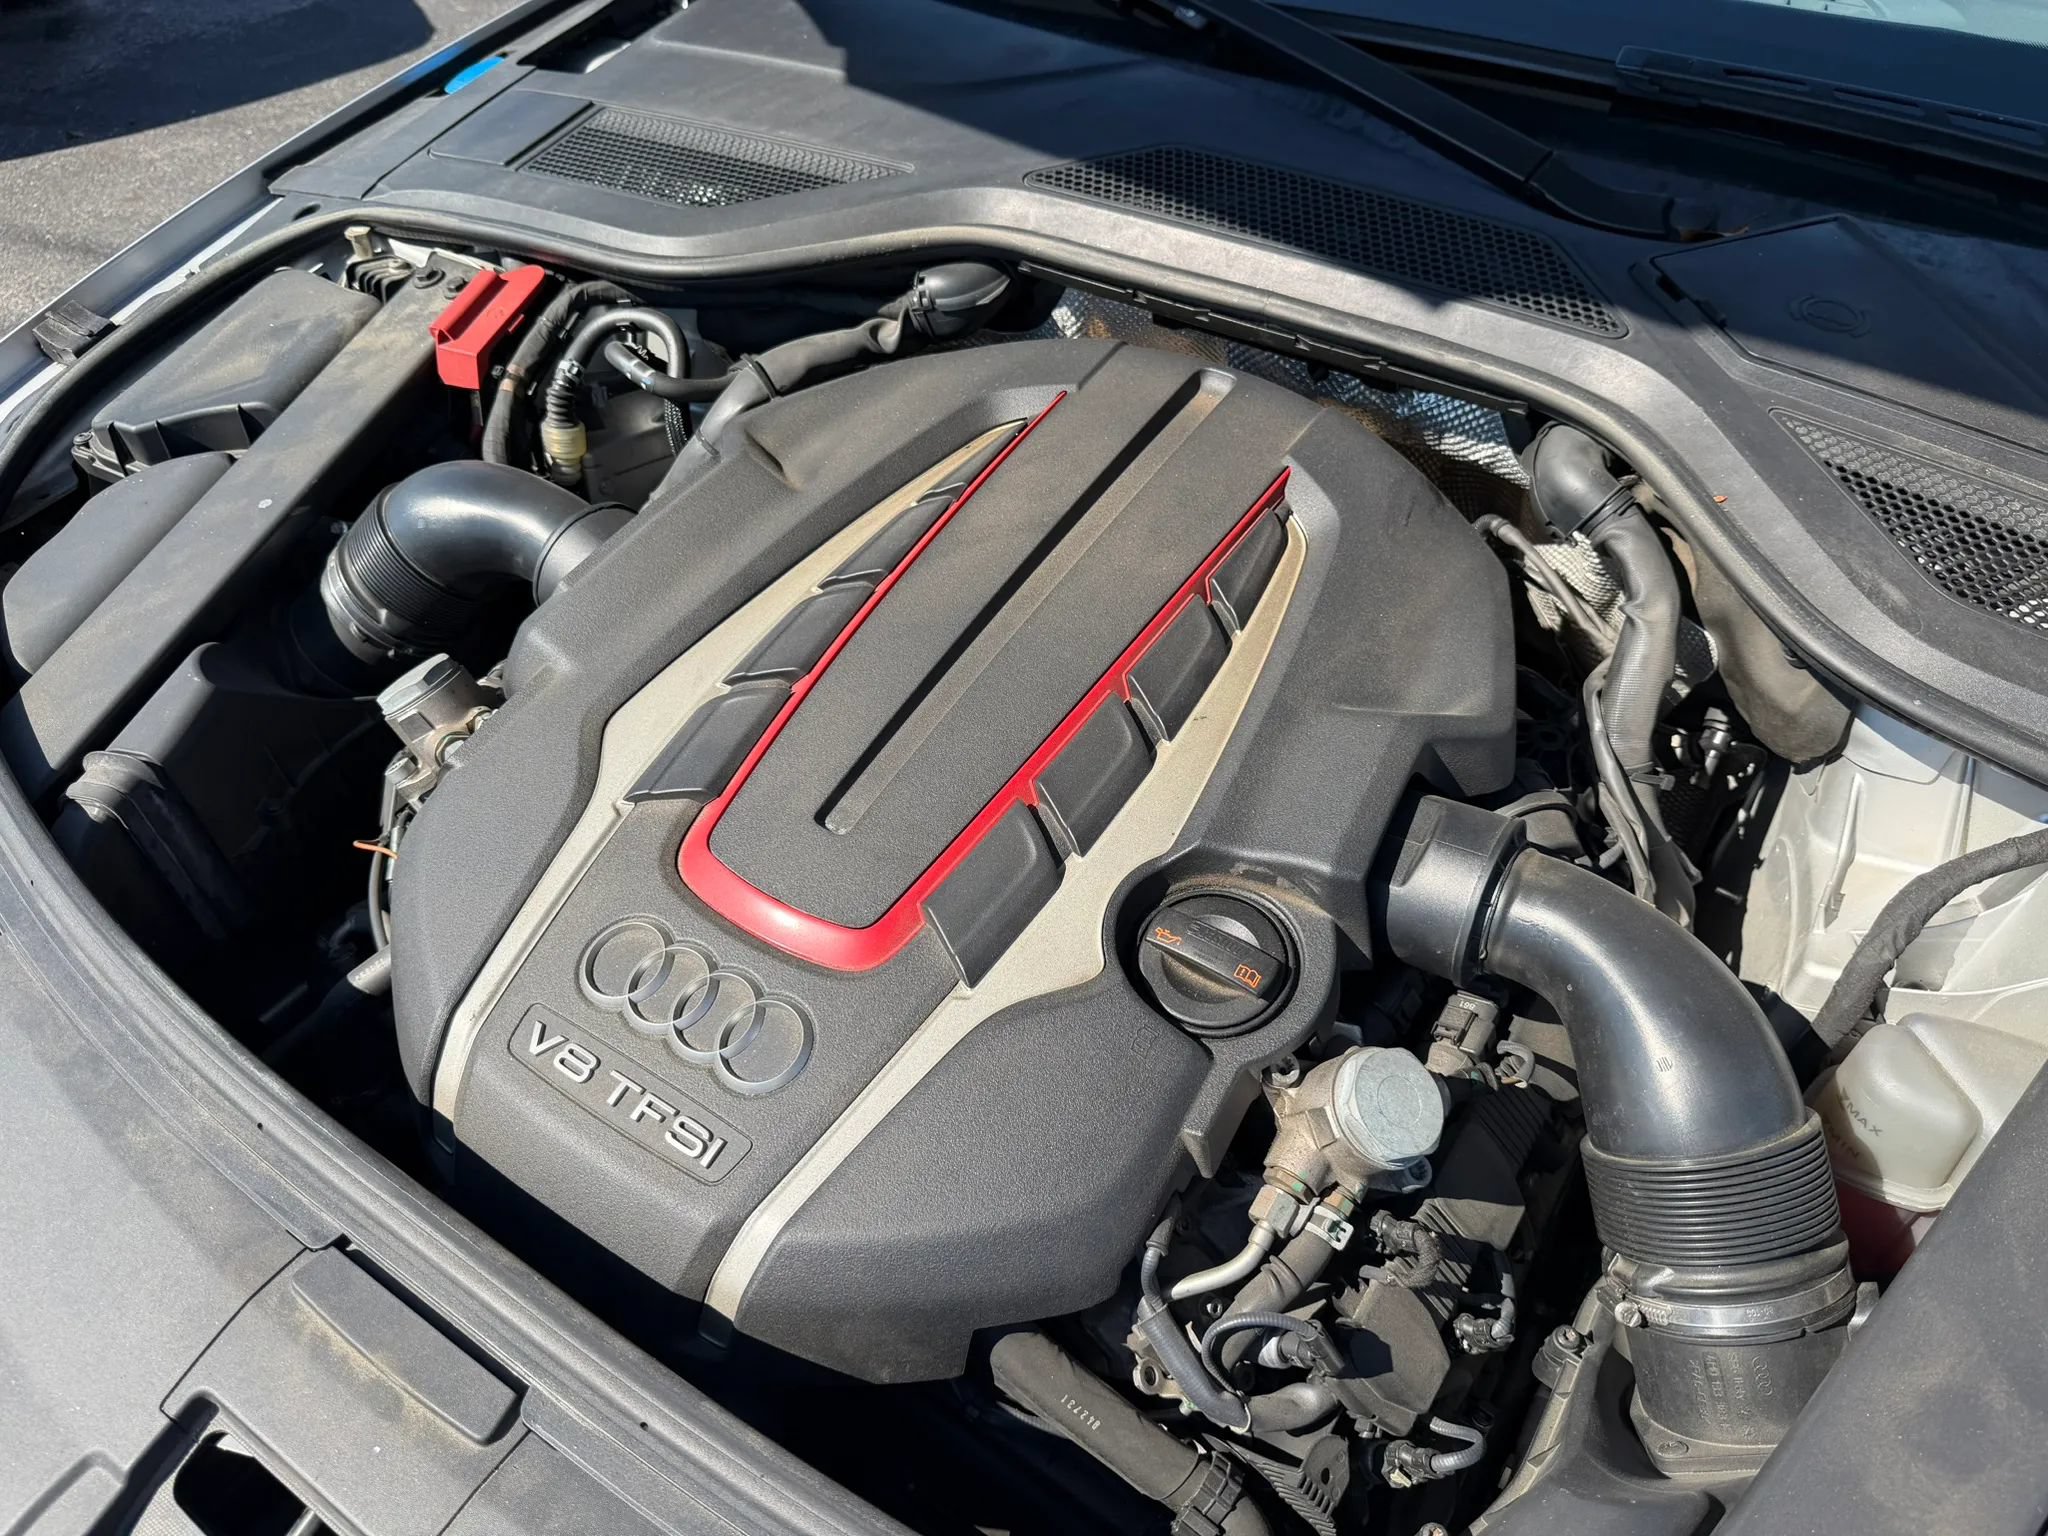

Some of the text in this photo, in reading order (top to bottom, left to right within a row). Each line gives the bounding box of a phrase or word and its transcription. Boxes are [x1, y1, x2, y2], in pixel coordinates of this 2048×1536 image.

[529, 1020, 728, 1169] V8 TFSI
[1846, 1102, 1883, 1136] MAX
